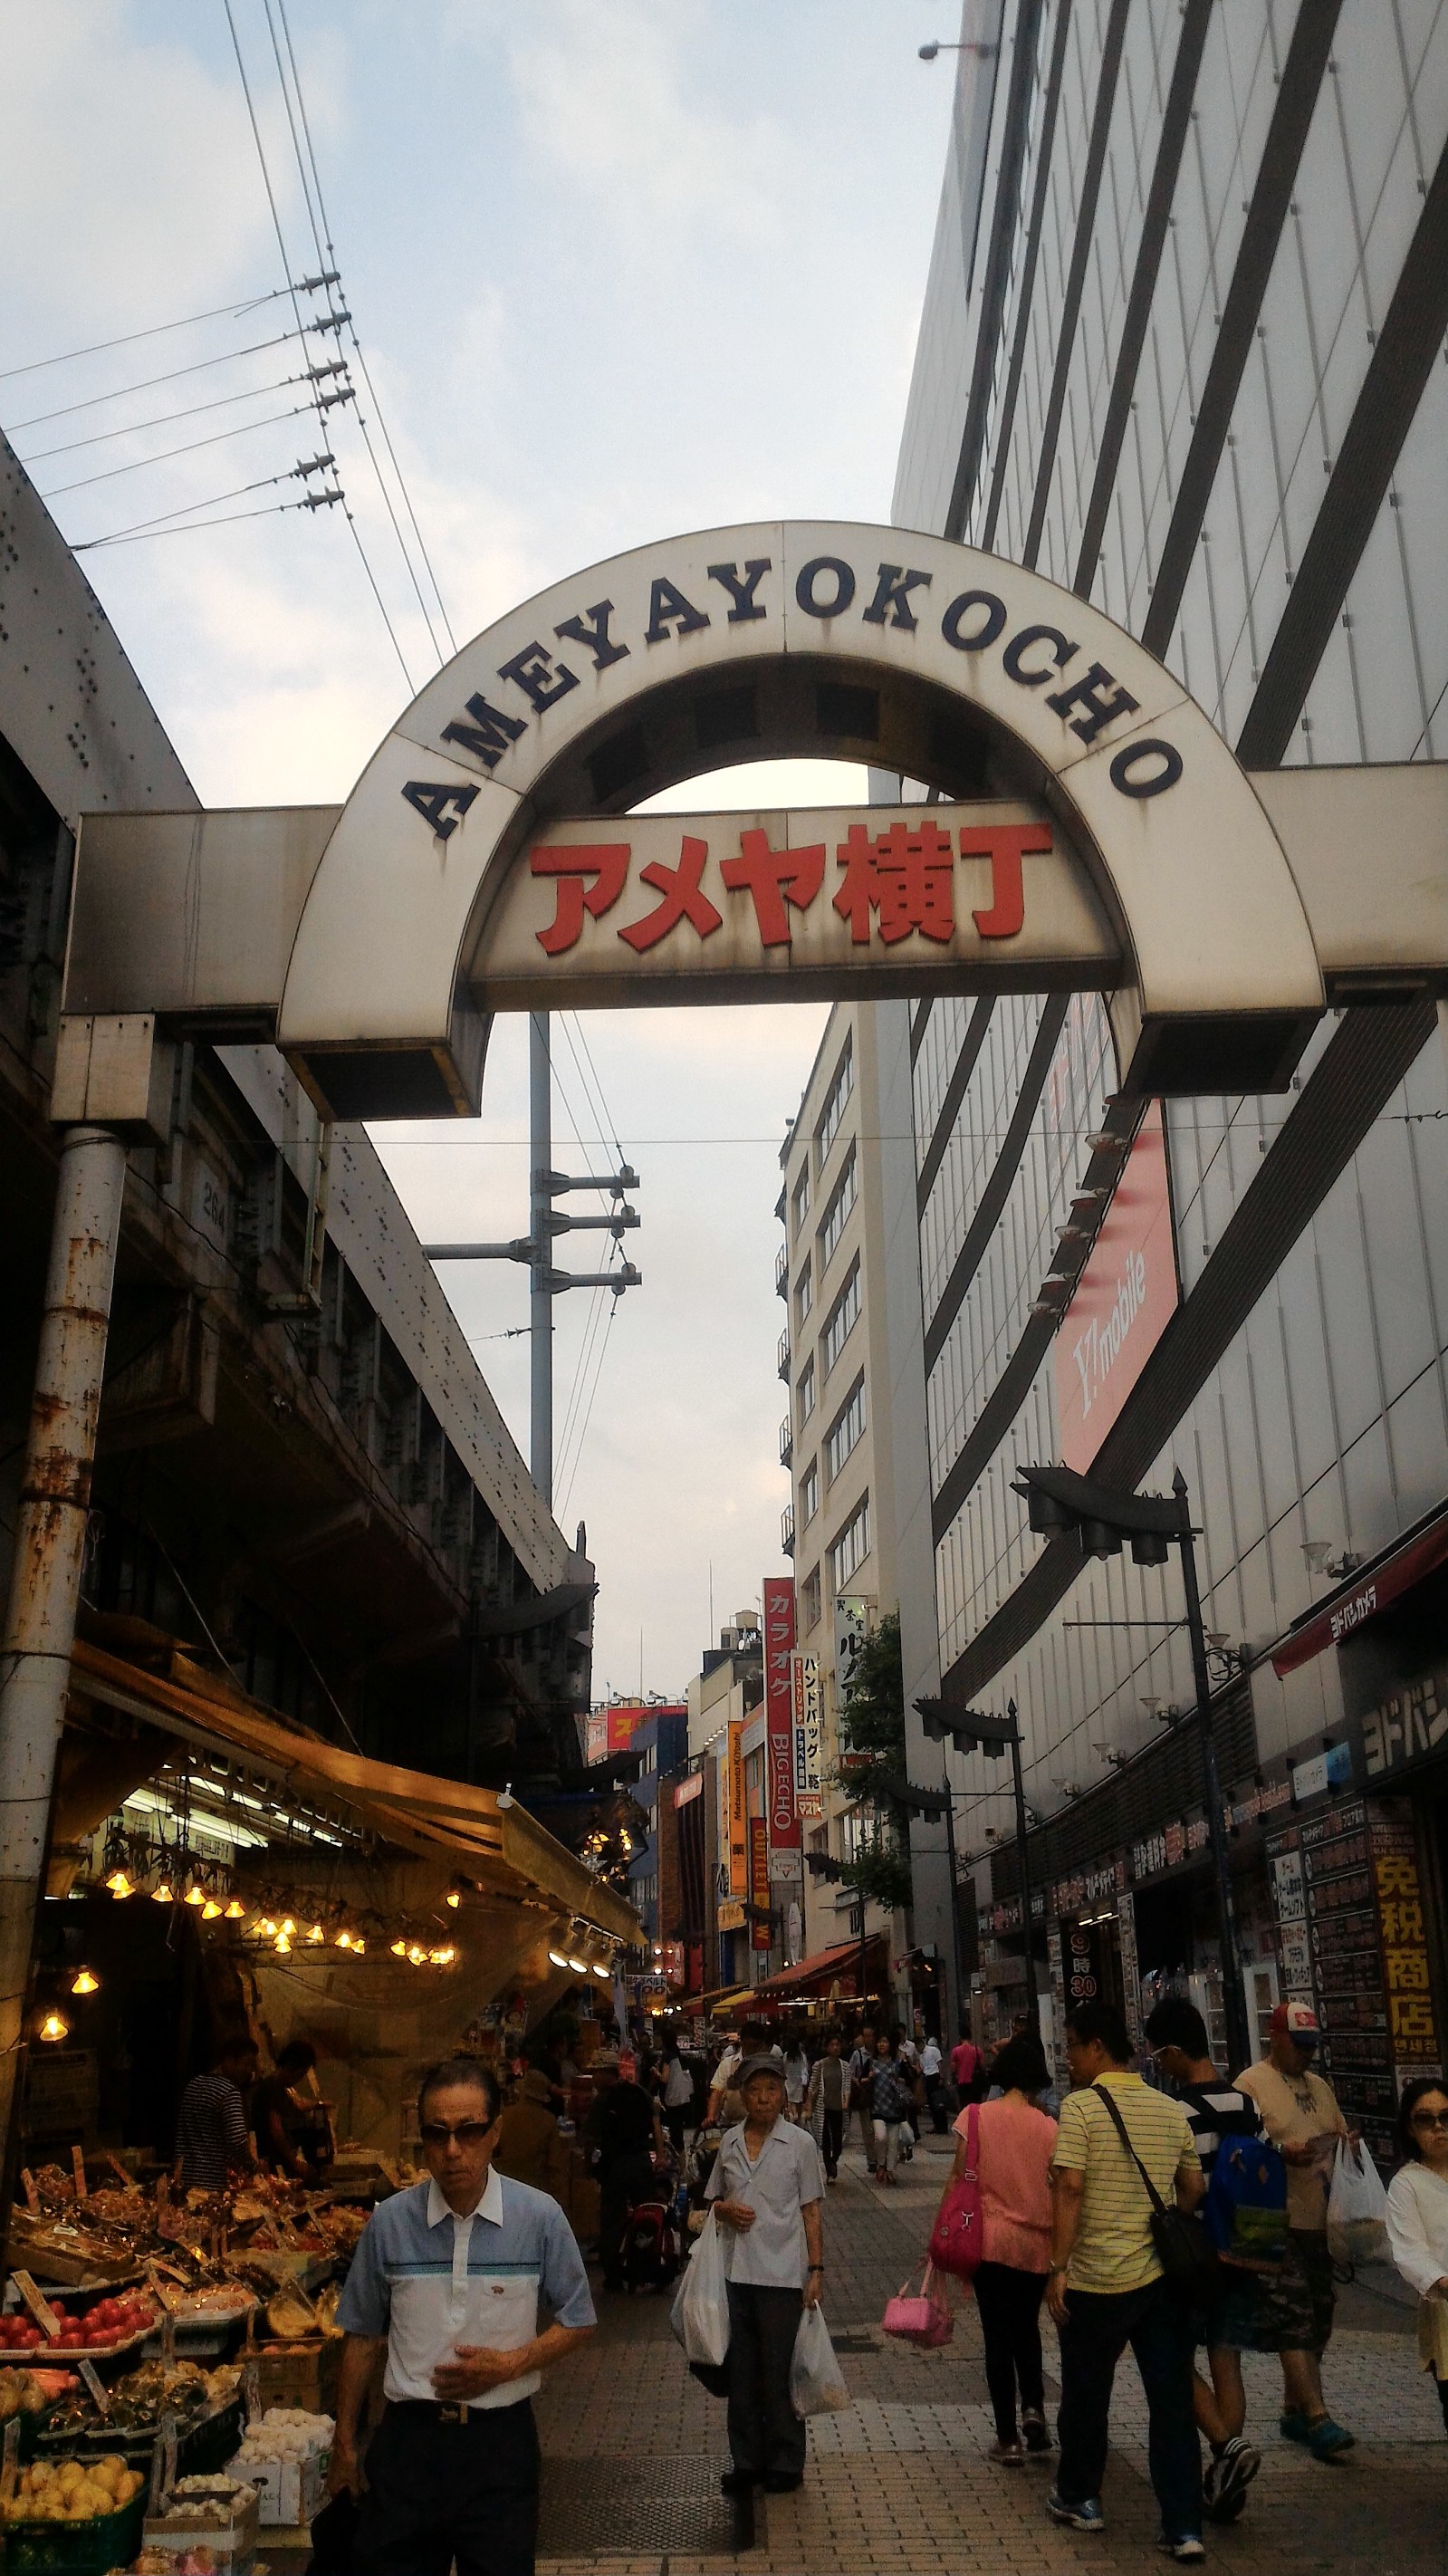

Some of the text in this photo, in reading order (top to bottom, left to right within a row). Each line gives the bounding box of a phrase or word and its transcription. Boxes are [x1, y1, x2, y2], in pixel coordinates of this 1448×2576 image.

[402, 557, 1184, 840] AMEYAYOKOCHO
[530, 820, 1053, 956] アメヤ横丁
[769, 1593, 793, 1697] カラオケ
[772, 1733, 791, 1831] BIG ECHO
[1375, 1854, 1434, 2037] 免税商店
